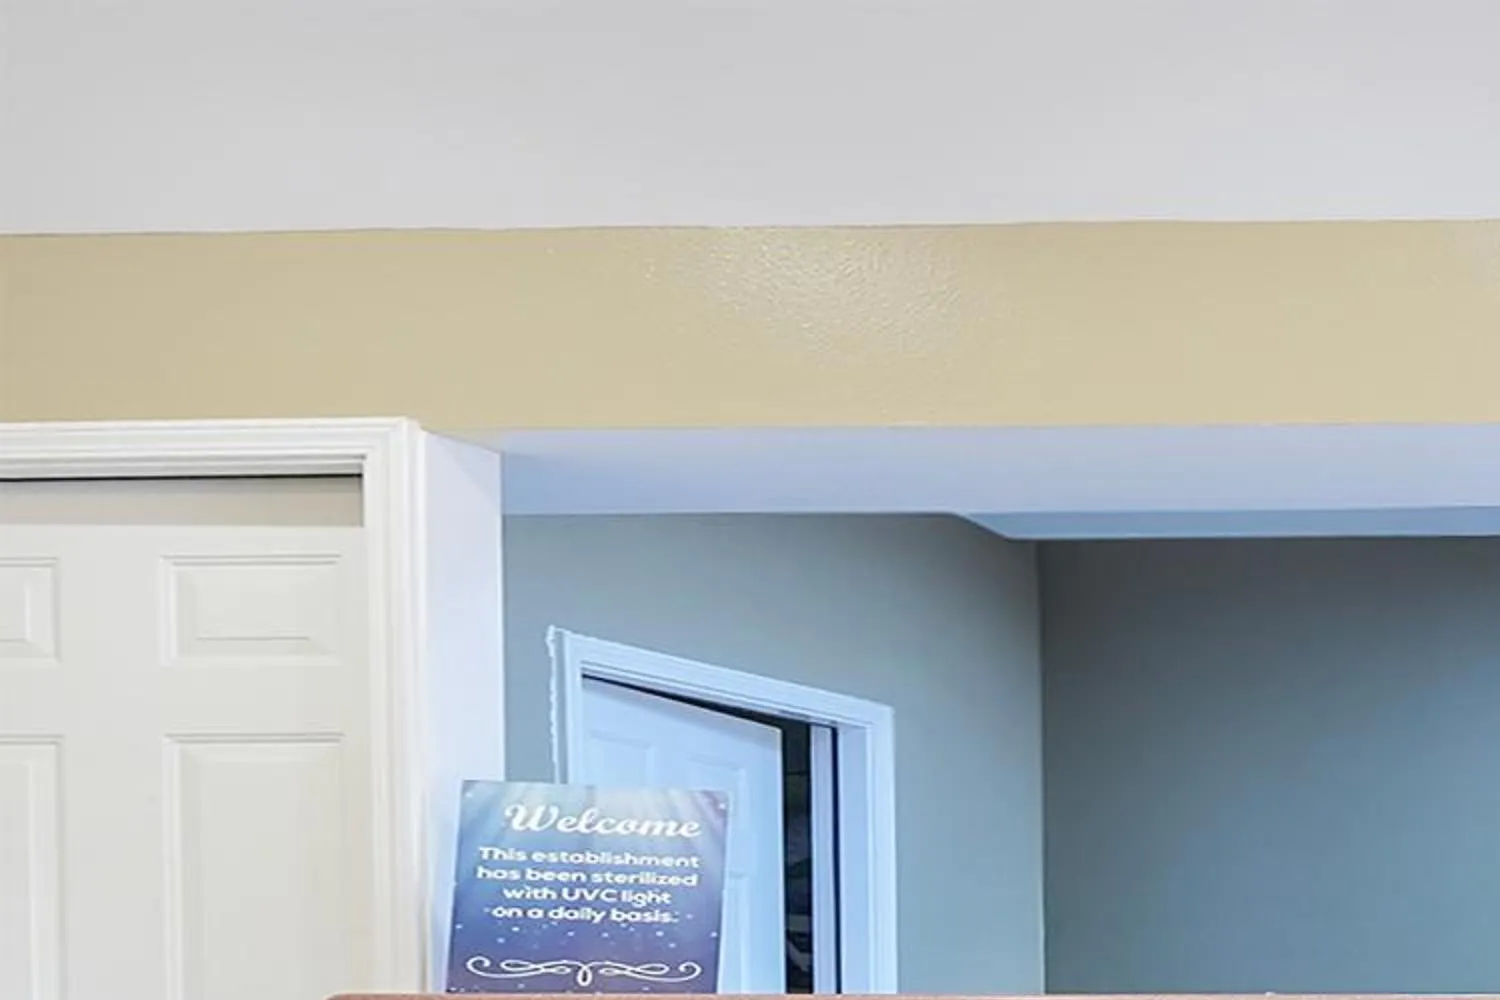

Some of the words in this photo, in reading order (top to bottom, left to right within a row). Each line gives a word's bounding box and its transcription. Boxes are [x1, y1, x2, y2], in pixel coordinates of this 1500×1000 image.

[504, 804, 701, 838] Welcome
[479, 847, 527, 861] This
[532, 853, 700, 868] establishment
[477, 867, 521, 881] has
[526, 868, 586, 882] been
[591, 871, 699, 886] sterilized
[504, 886, 556, 900] with
[562, 888, 618, 901] UVC
[622, 889, 672, 907] light
[492, 906, 523, 919] on
[527, 908, 543, 919] a
[549, 907, 605, 924] daily
[610, 909, 679, 923] basis.
